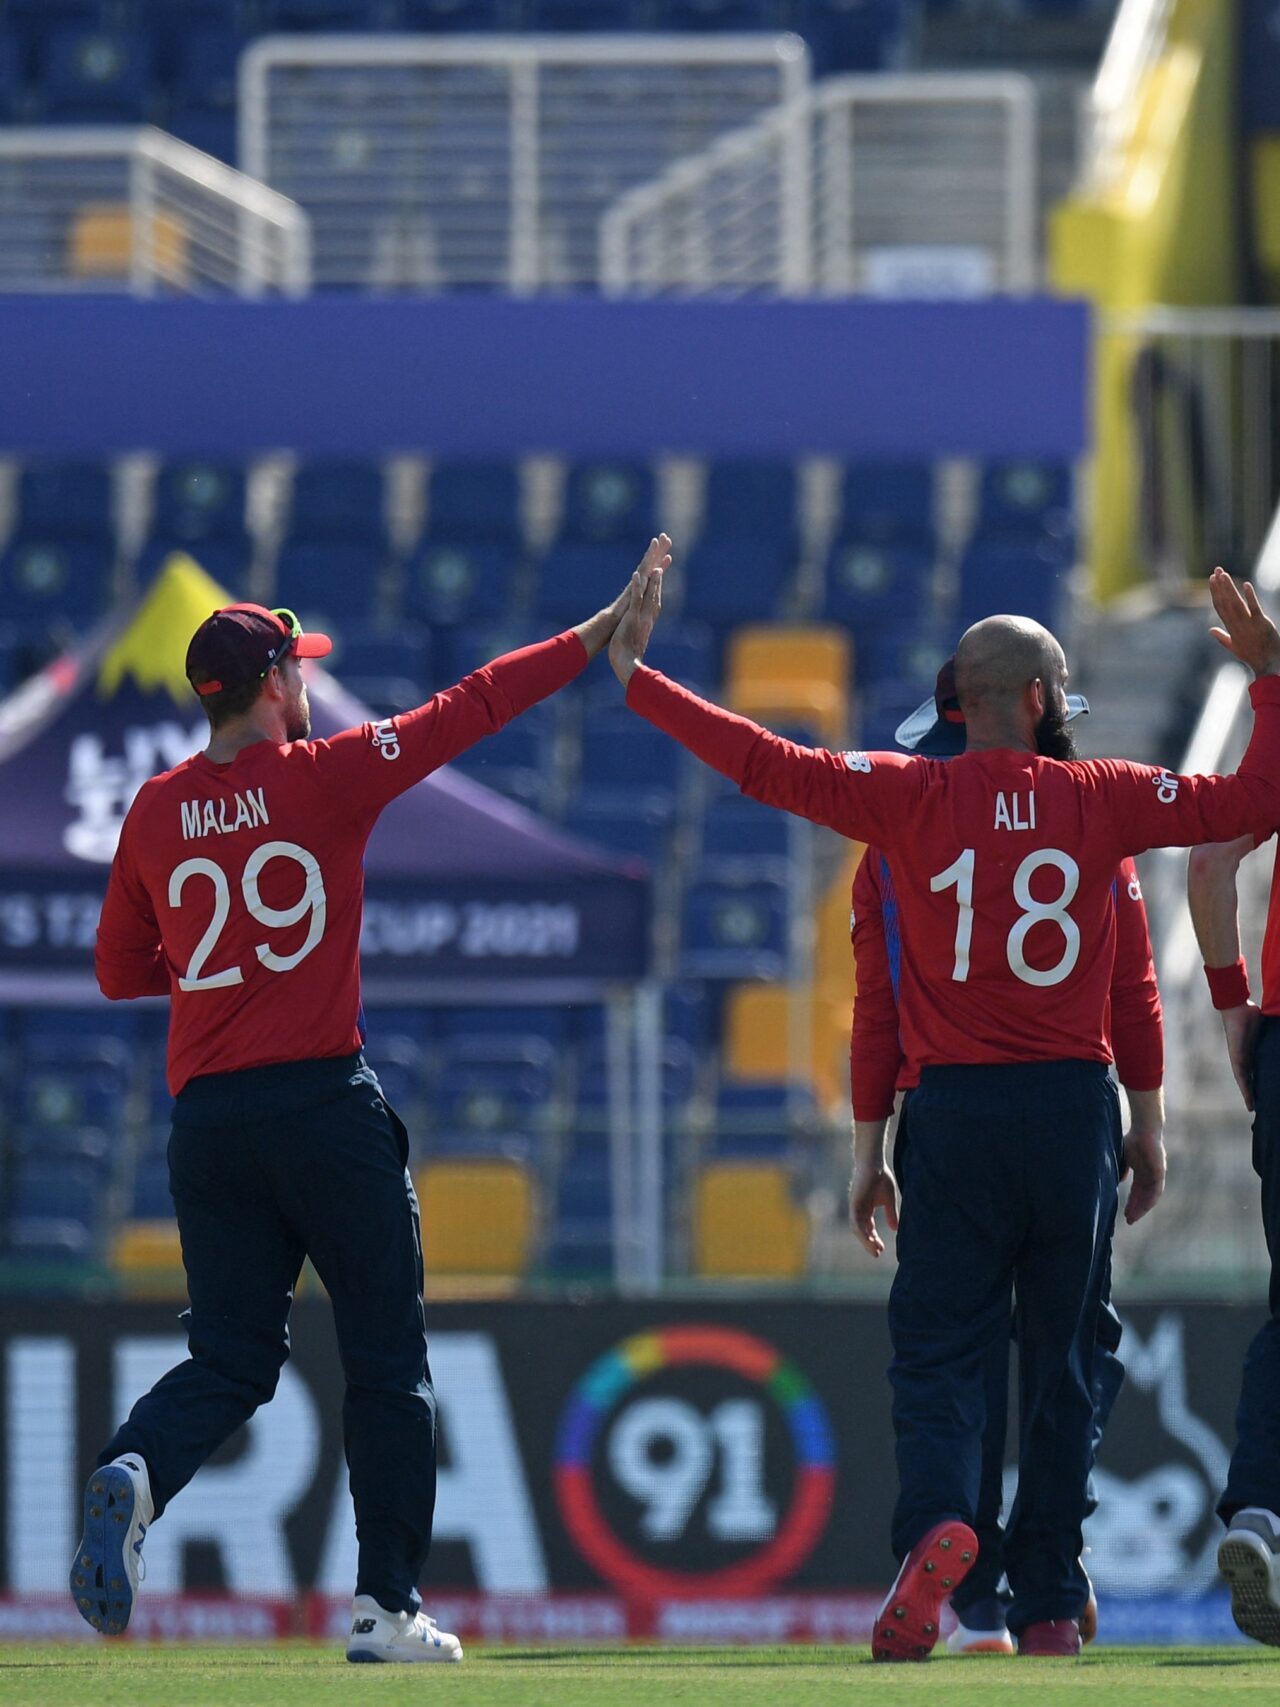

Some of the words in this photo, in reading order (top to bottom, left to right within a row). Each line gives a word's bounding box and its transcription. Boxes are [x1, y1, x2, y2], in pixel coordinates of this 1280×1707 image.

[180, 787, 270, 840] MALAN
[994, 790, 1036, 831] ALI
[168, 840, 327, 992] 29
[930, 848, 1081, 987] 18
[608, 1397, 780, 1544] 91
